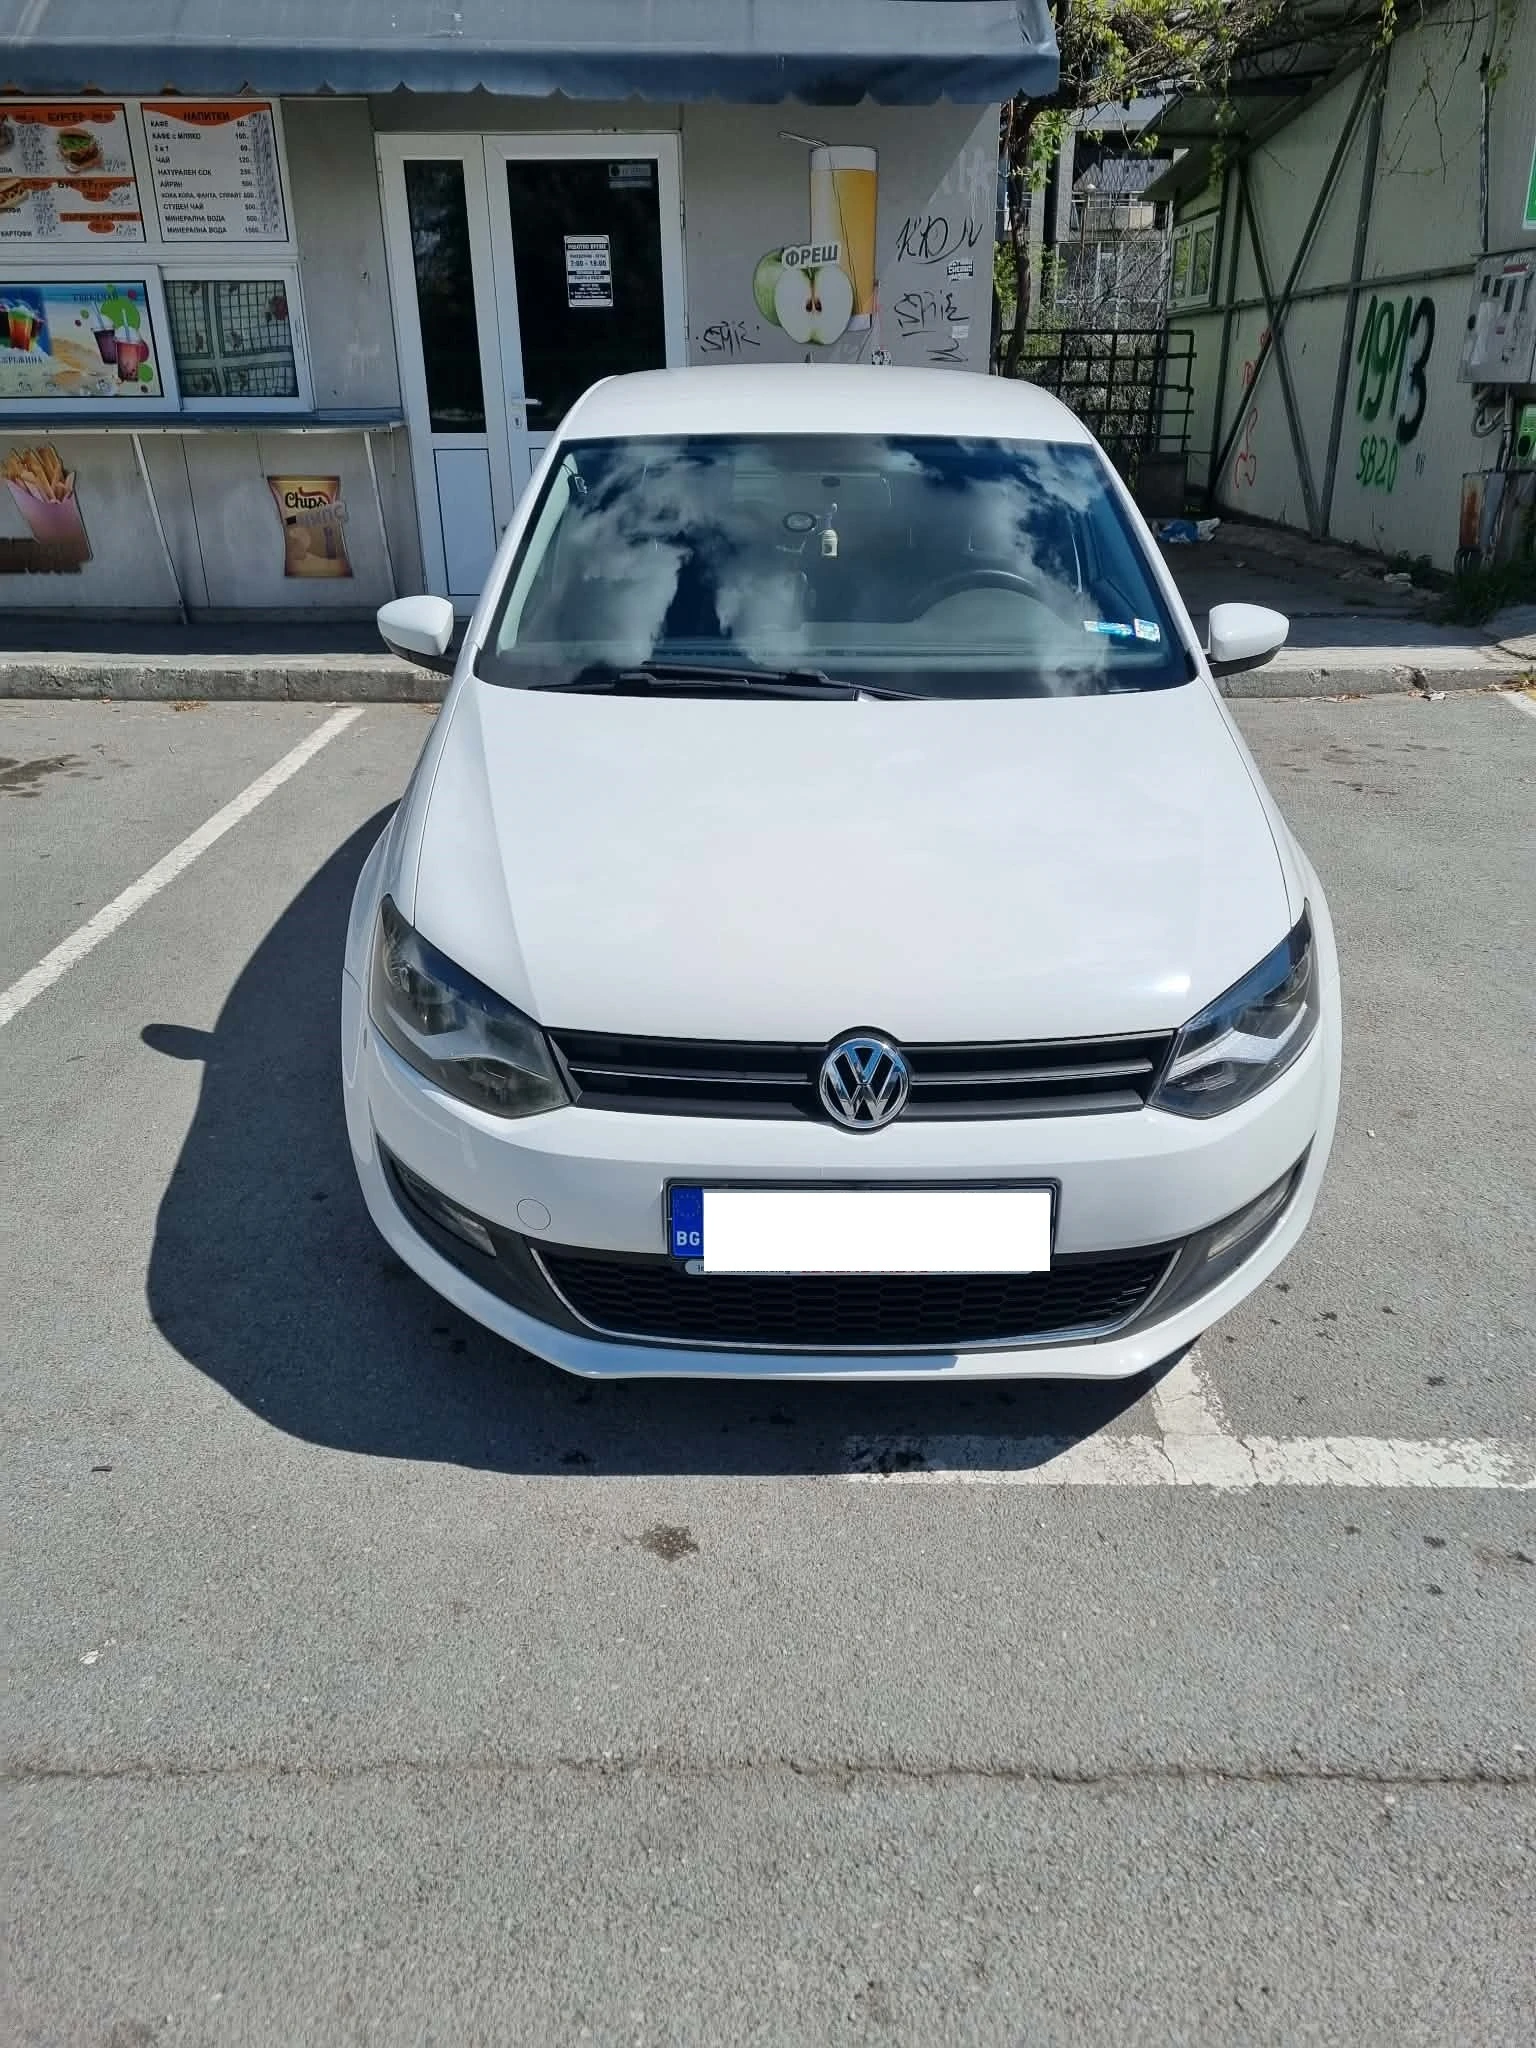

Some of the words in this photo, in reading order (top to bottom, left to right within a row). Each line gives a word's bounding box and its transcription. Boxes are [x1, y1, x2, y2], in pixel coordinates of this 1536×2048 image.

[183, 111, 230, 121] НАПИТКИ
[152, 132, 171, 140] КАФЕ
[177, 132, 201, 140] МЛЯКО
[156, 156, 171, 164] ЧАЙ
[158, 168, 197, 176] НАТУРАЛЕН
[785, 244, 838, 266] ФРЕШ
[1357, 295, 1436, 445] 1913
[821, 1040, 907, 1127] VW
[676, 1231, 701, 1247] BG
